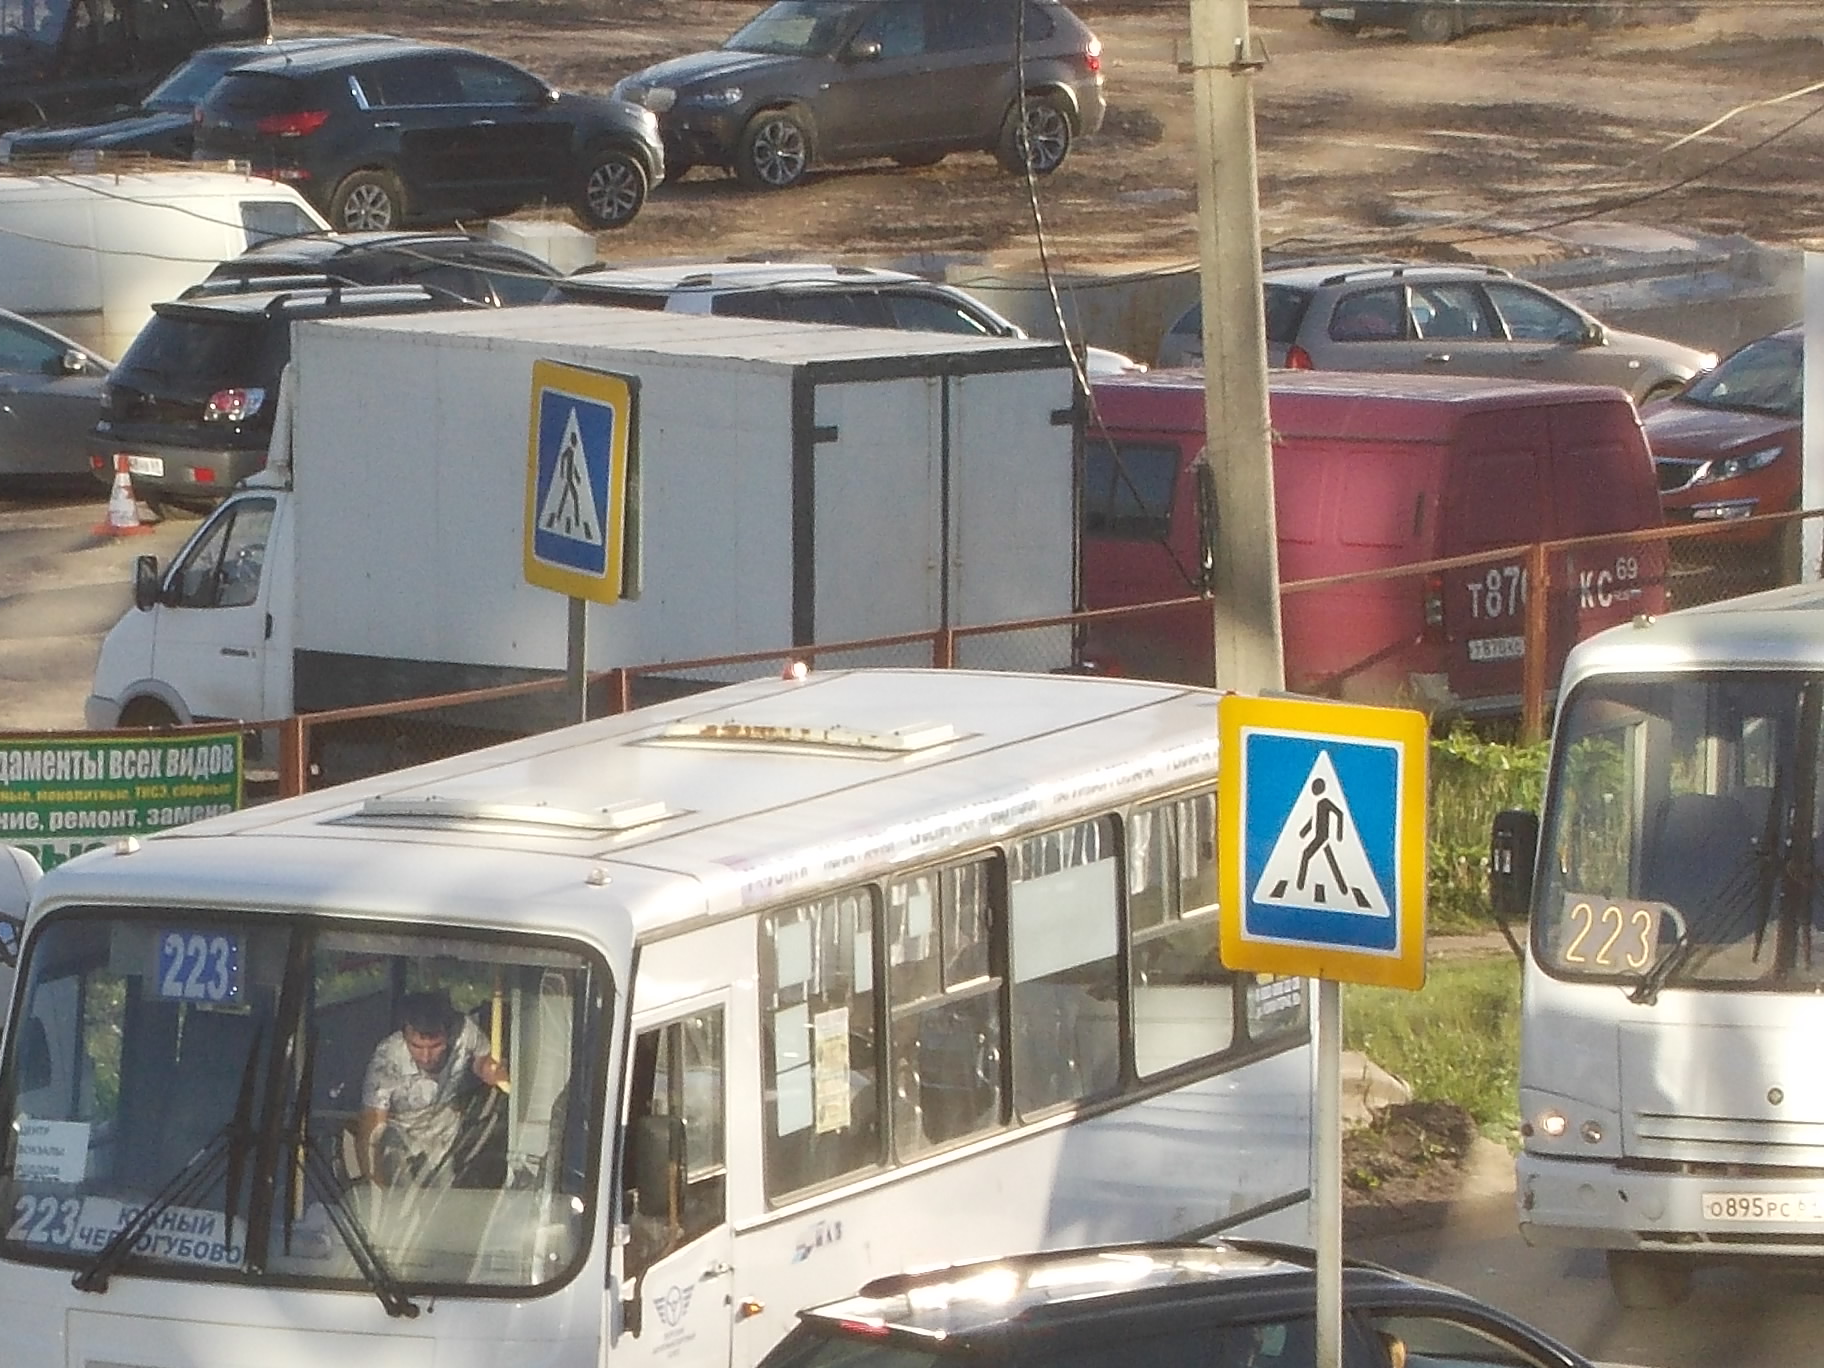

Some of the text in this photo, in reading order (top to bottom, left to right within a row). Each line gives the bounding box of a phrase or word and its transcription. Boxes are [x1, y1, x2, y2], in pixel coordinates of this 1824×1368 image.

[1467, 566, 1526, 619] Т87
[1615, 557, 1638, 580] 69
[109, 748, 162, 780] всех
[165, 743, 234, 781] видов
[1566, 903, 1652, 968] 223
[162, 932, 229, 1000] 223
[6, 1194, 81, 1246] 223
